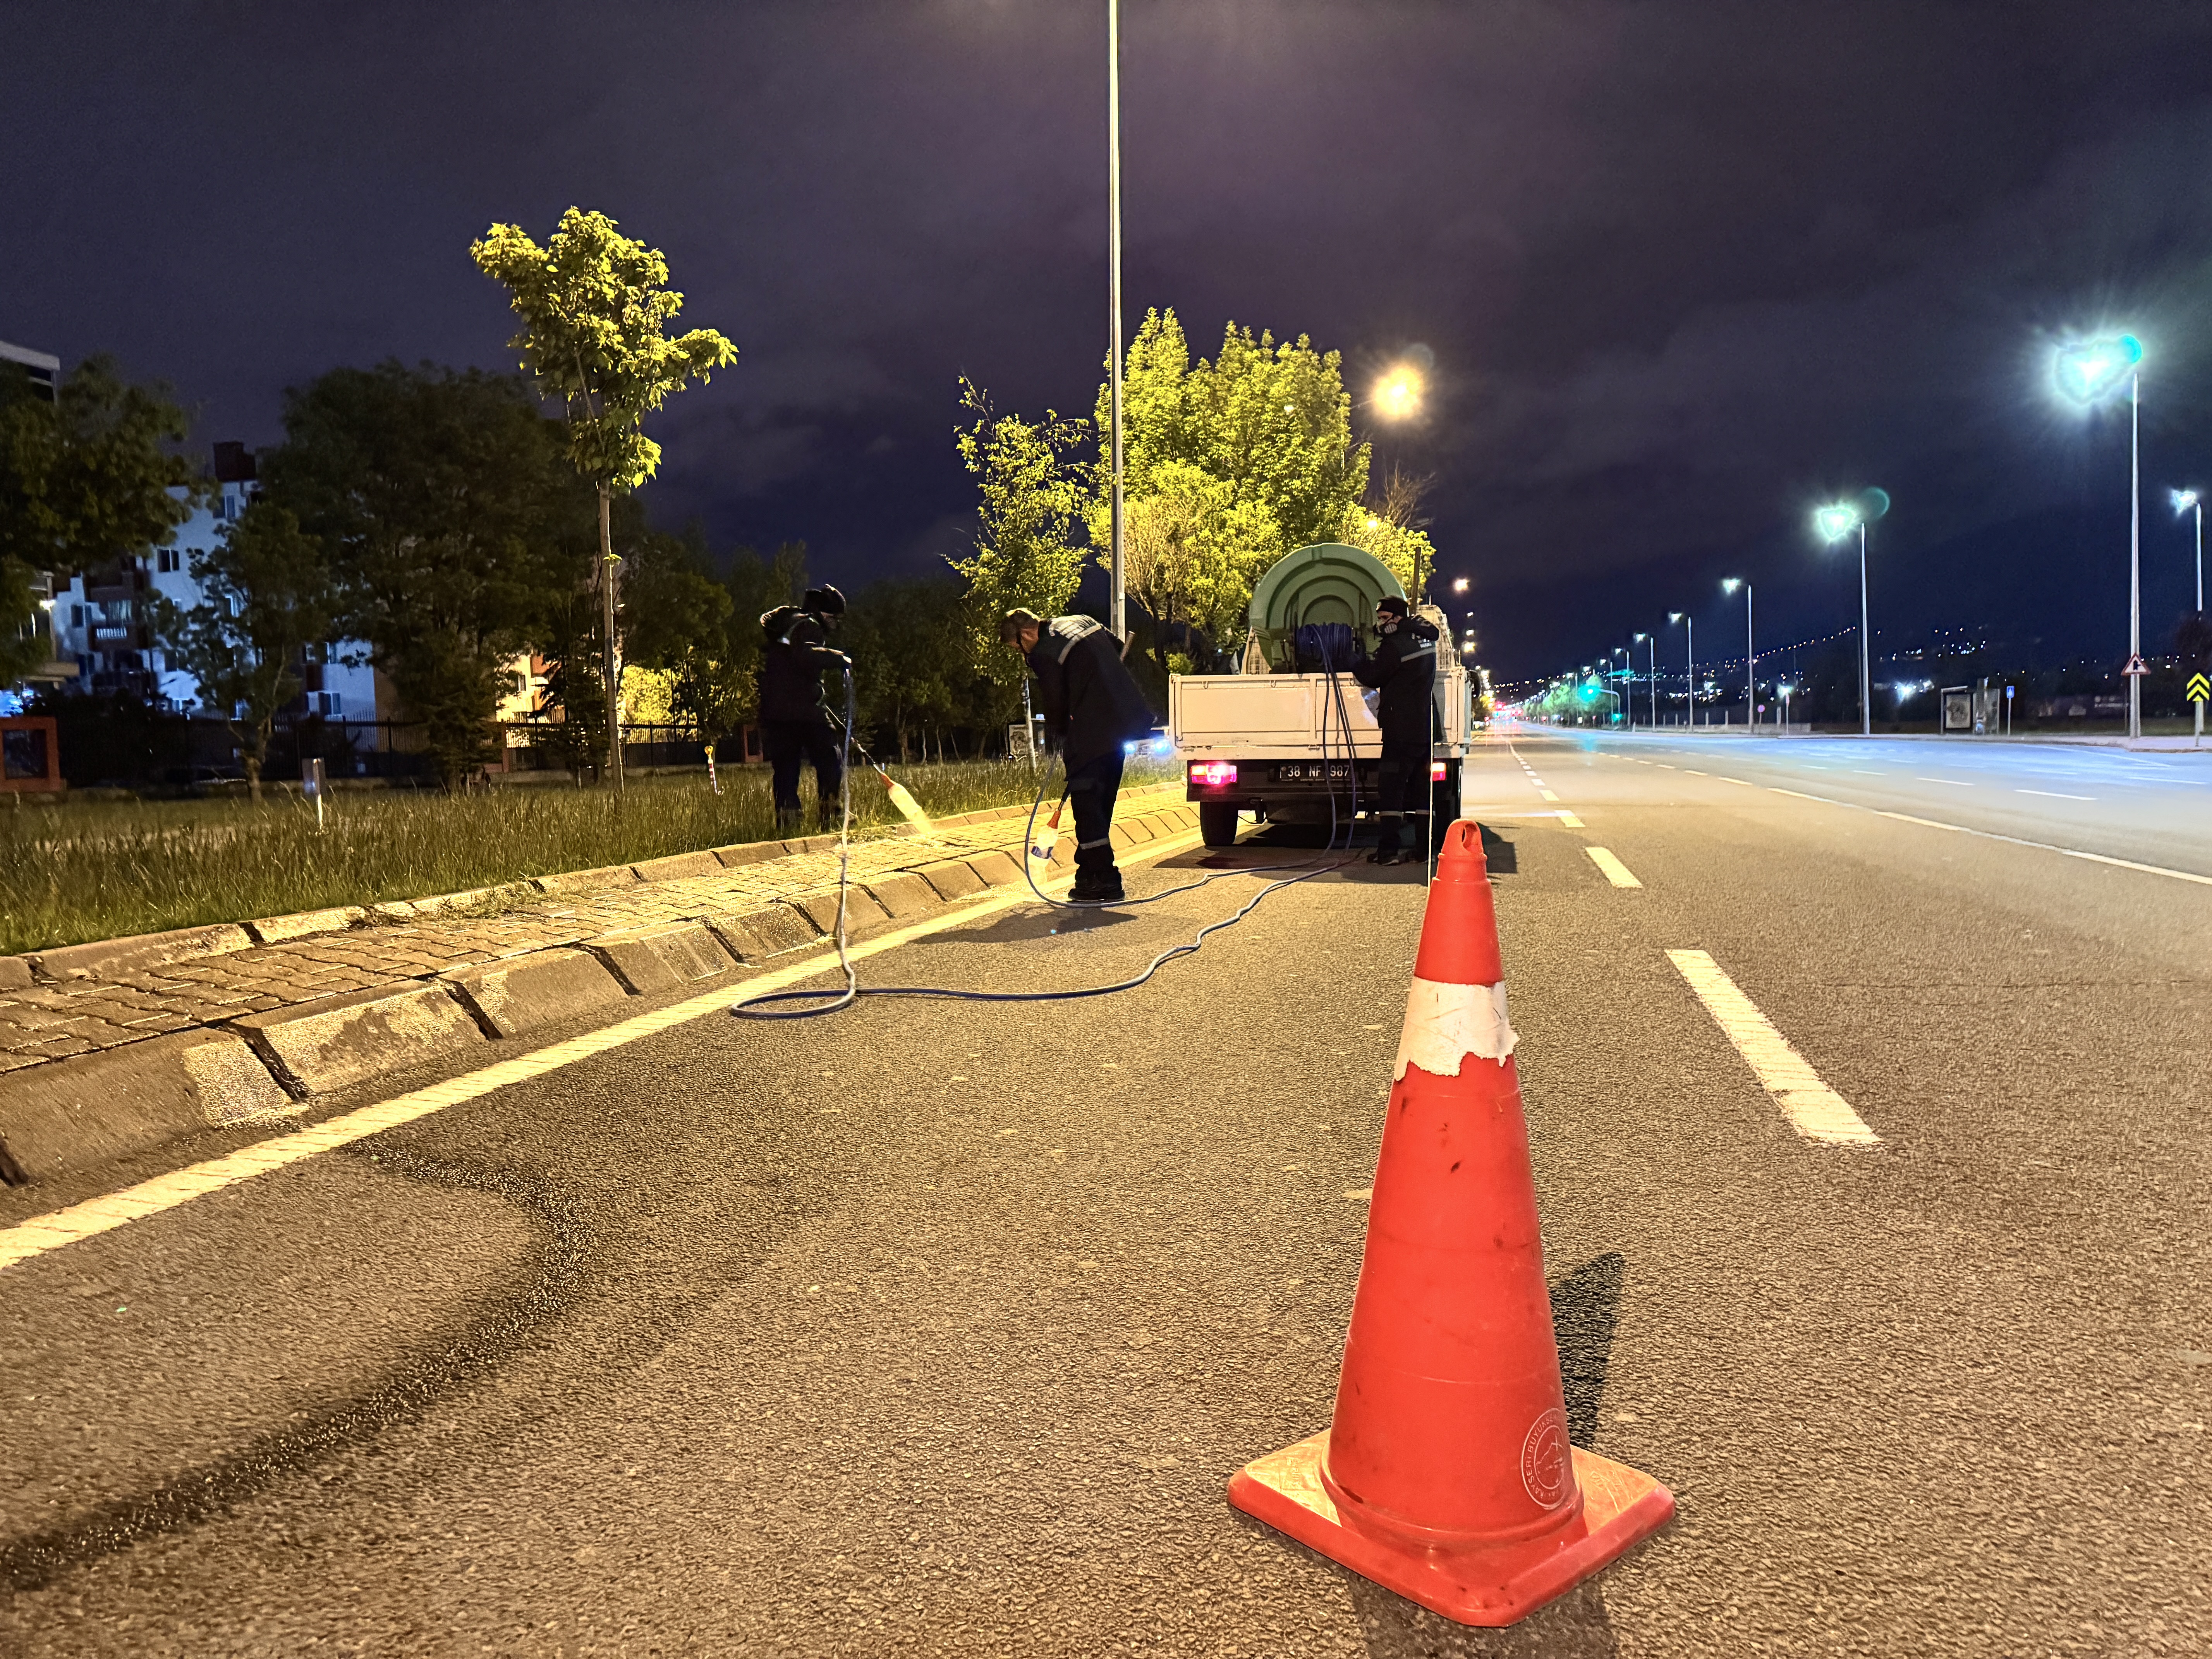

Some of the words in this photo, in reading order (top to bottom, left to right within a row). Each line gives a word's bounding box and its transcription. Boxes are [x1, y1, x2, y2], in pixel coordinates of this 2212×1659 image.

[1288, 765, 1300, 777] 38
[1309, 765, 1321, 777] NF
[1330, 765, 1350, 777] 987
